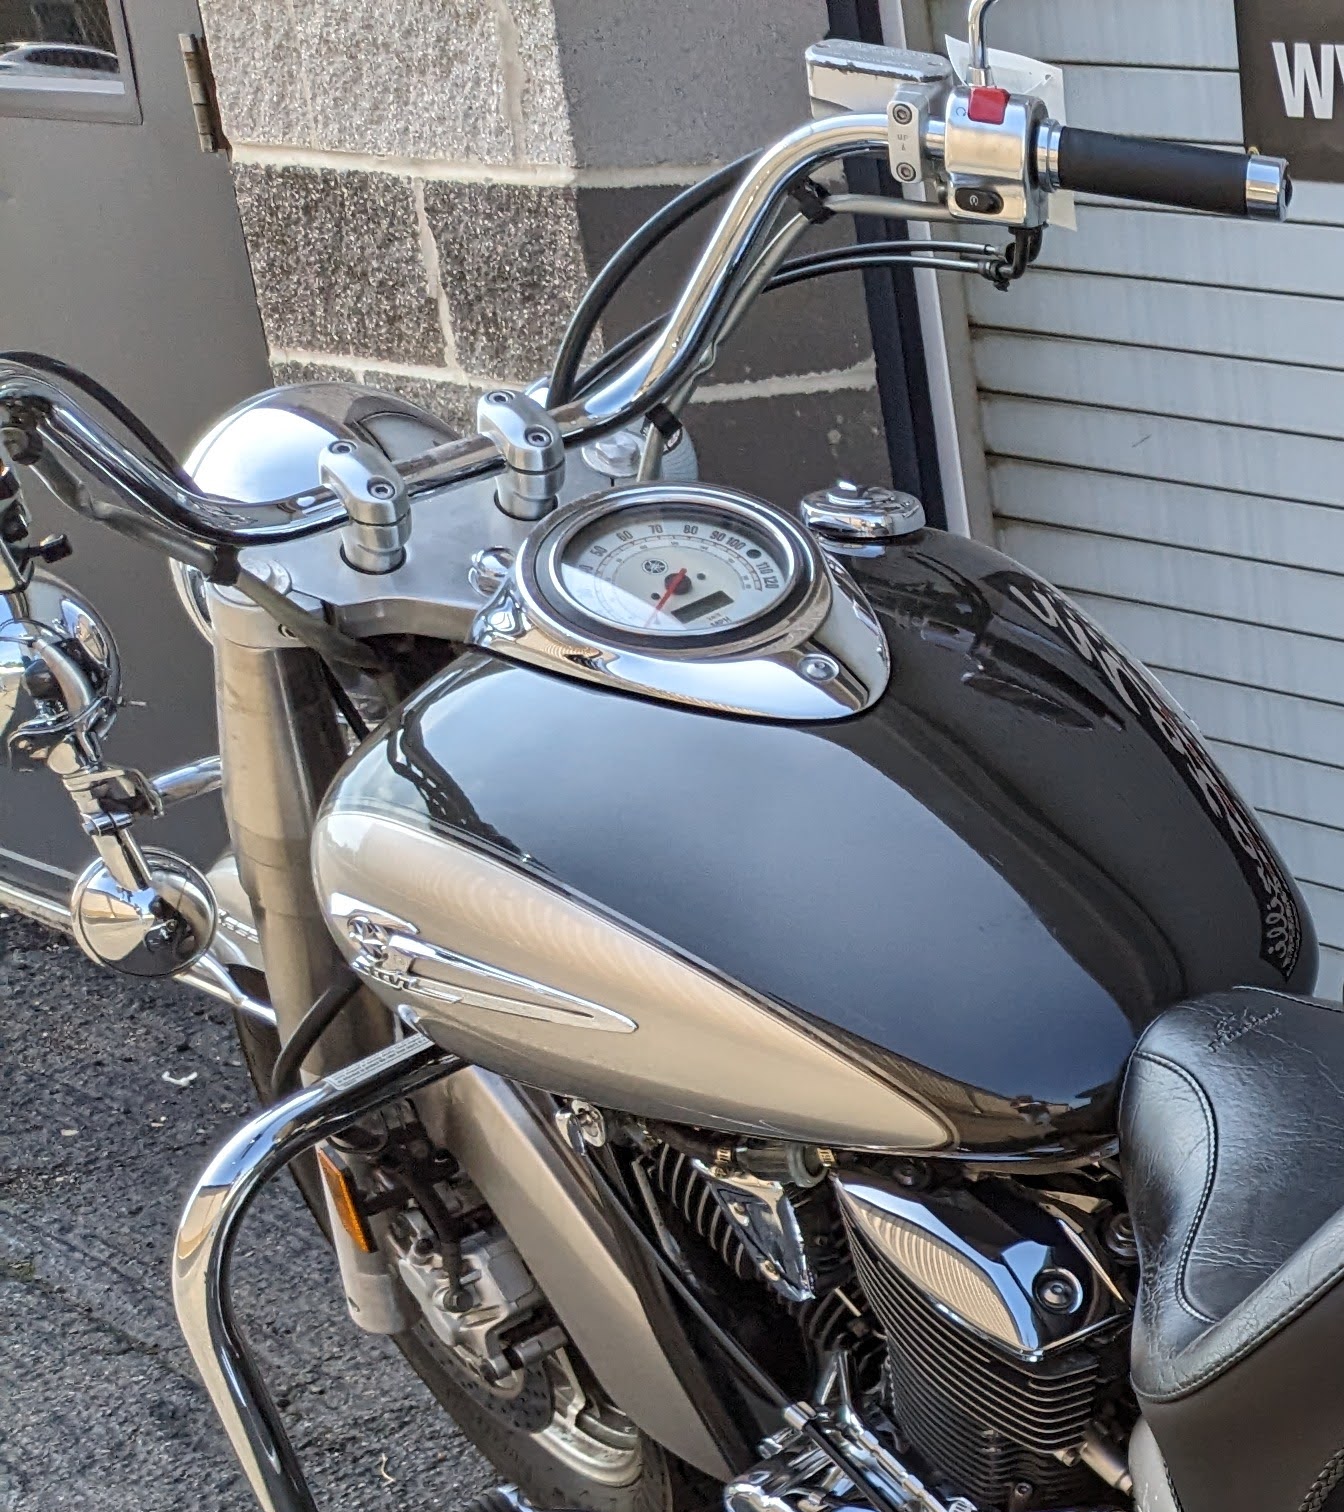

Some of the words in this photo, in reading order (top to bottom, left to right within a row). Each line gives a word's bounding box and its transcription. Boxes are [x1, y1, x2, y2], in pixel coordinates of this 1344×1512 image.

[648, 524, 664, 534] 70
[683, 524, 699, 535] 80
[616, 530, 634, 542] 60
[709, 530, 727, 542] 90
[726, 536, 746, 551] 100
[589, 545, 608, 557] 50
[755, 560, 774, 575] 110
[763, 575, 780, 589] 120
